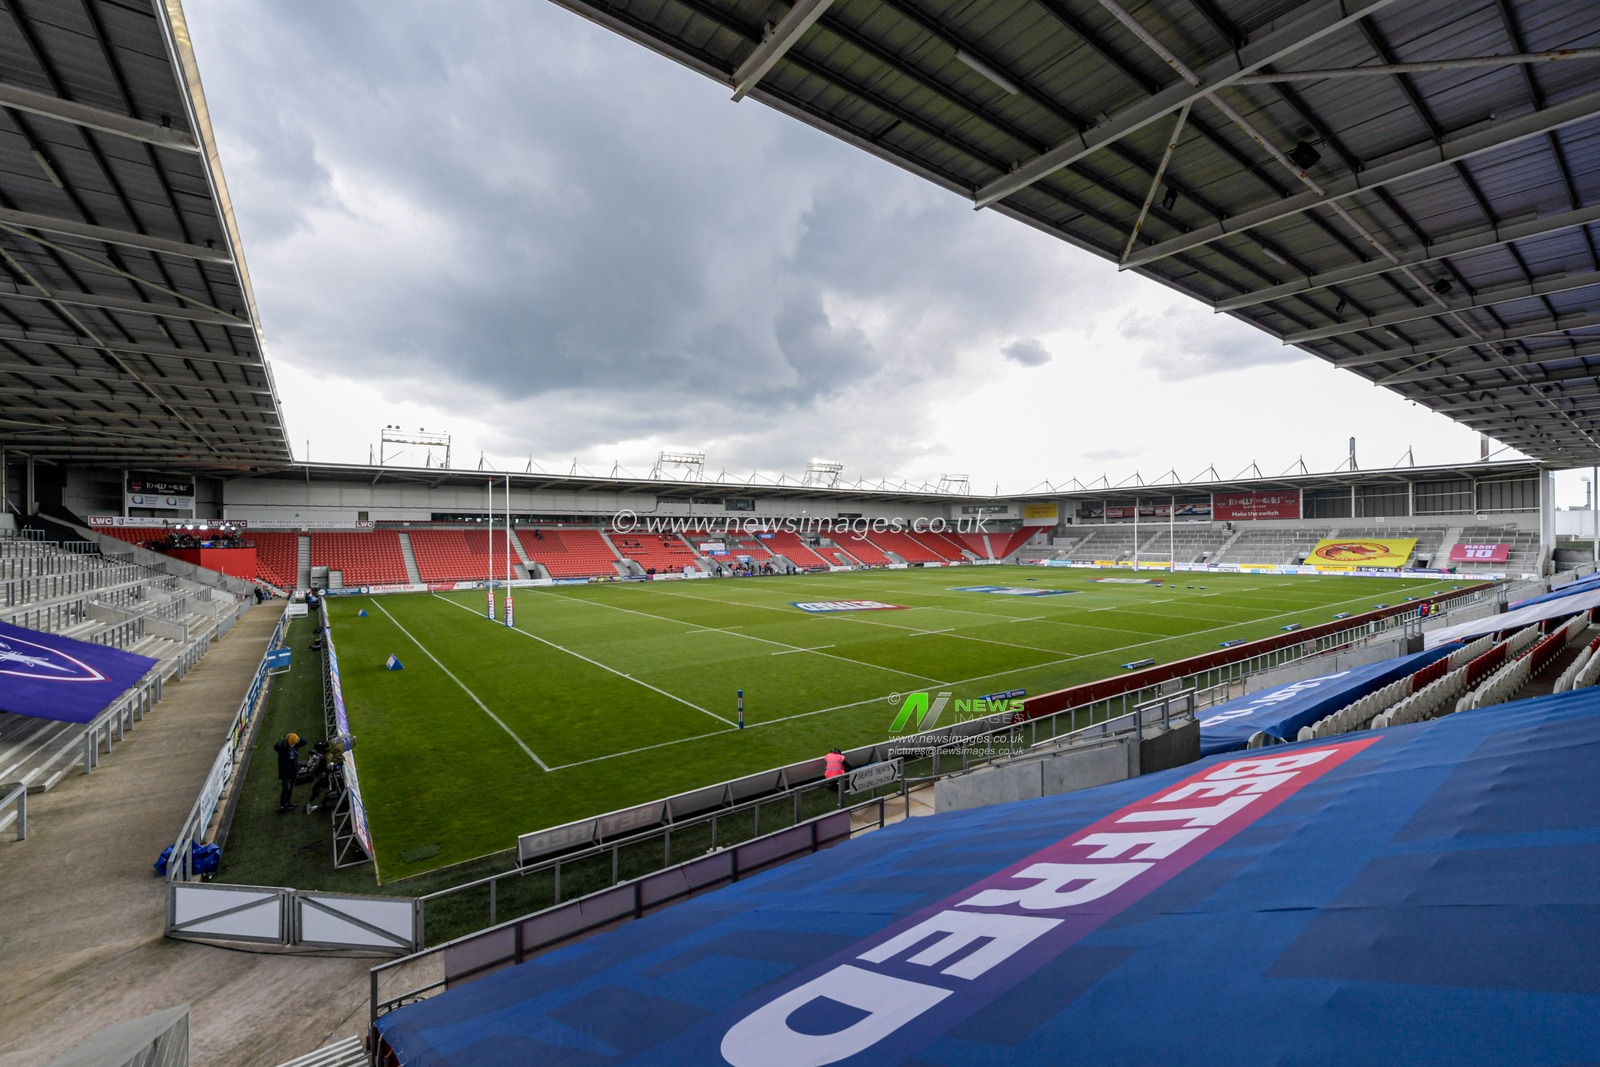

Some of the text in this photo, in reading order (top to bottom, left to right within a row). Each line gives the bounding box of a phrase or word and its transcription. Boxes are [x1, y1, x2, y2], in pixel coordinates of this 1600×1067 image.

[90, 517, 112, 525] LWC
[1466, 549, 1493, 558] 10
[858, 765, 891, 780] SEATS SEATS
[719, 748, 1340, 1067] BETFRED
